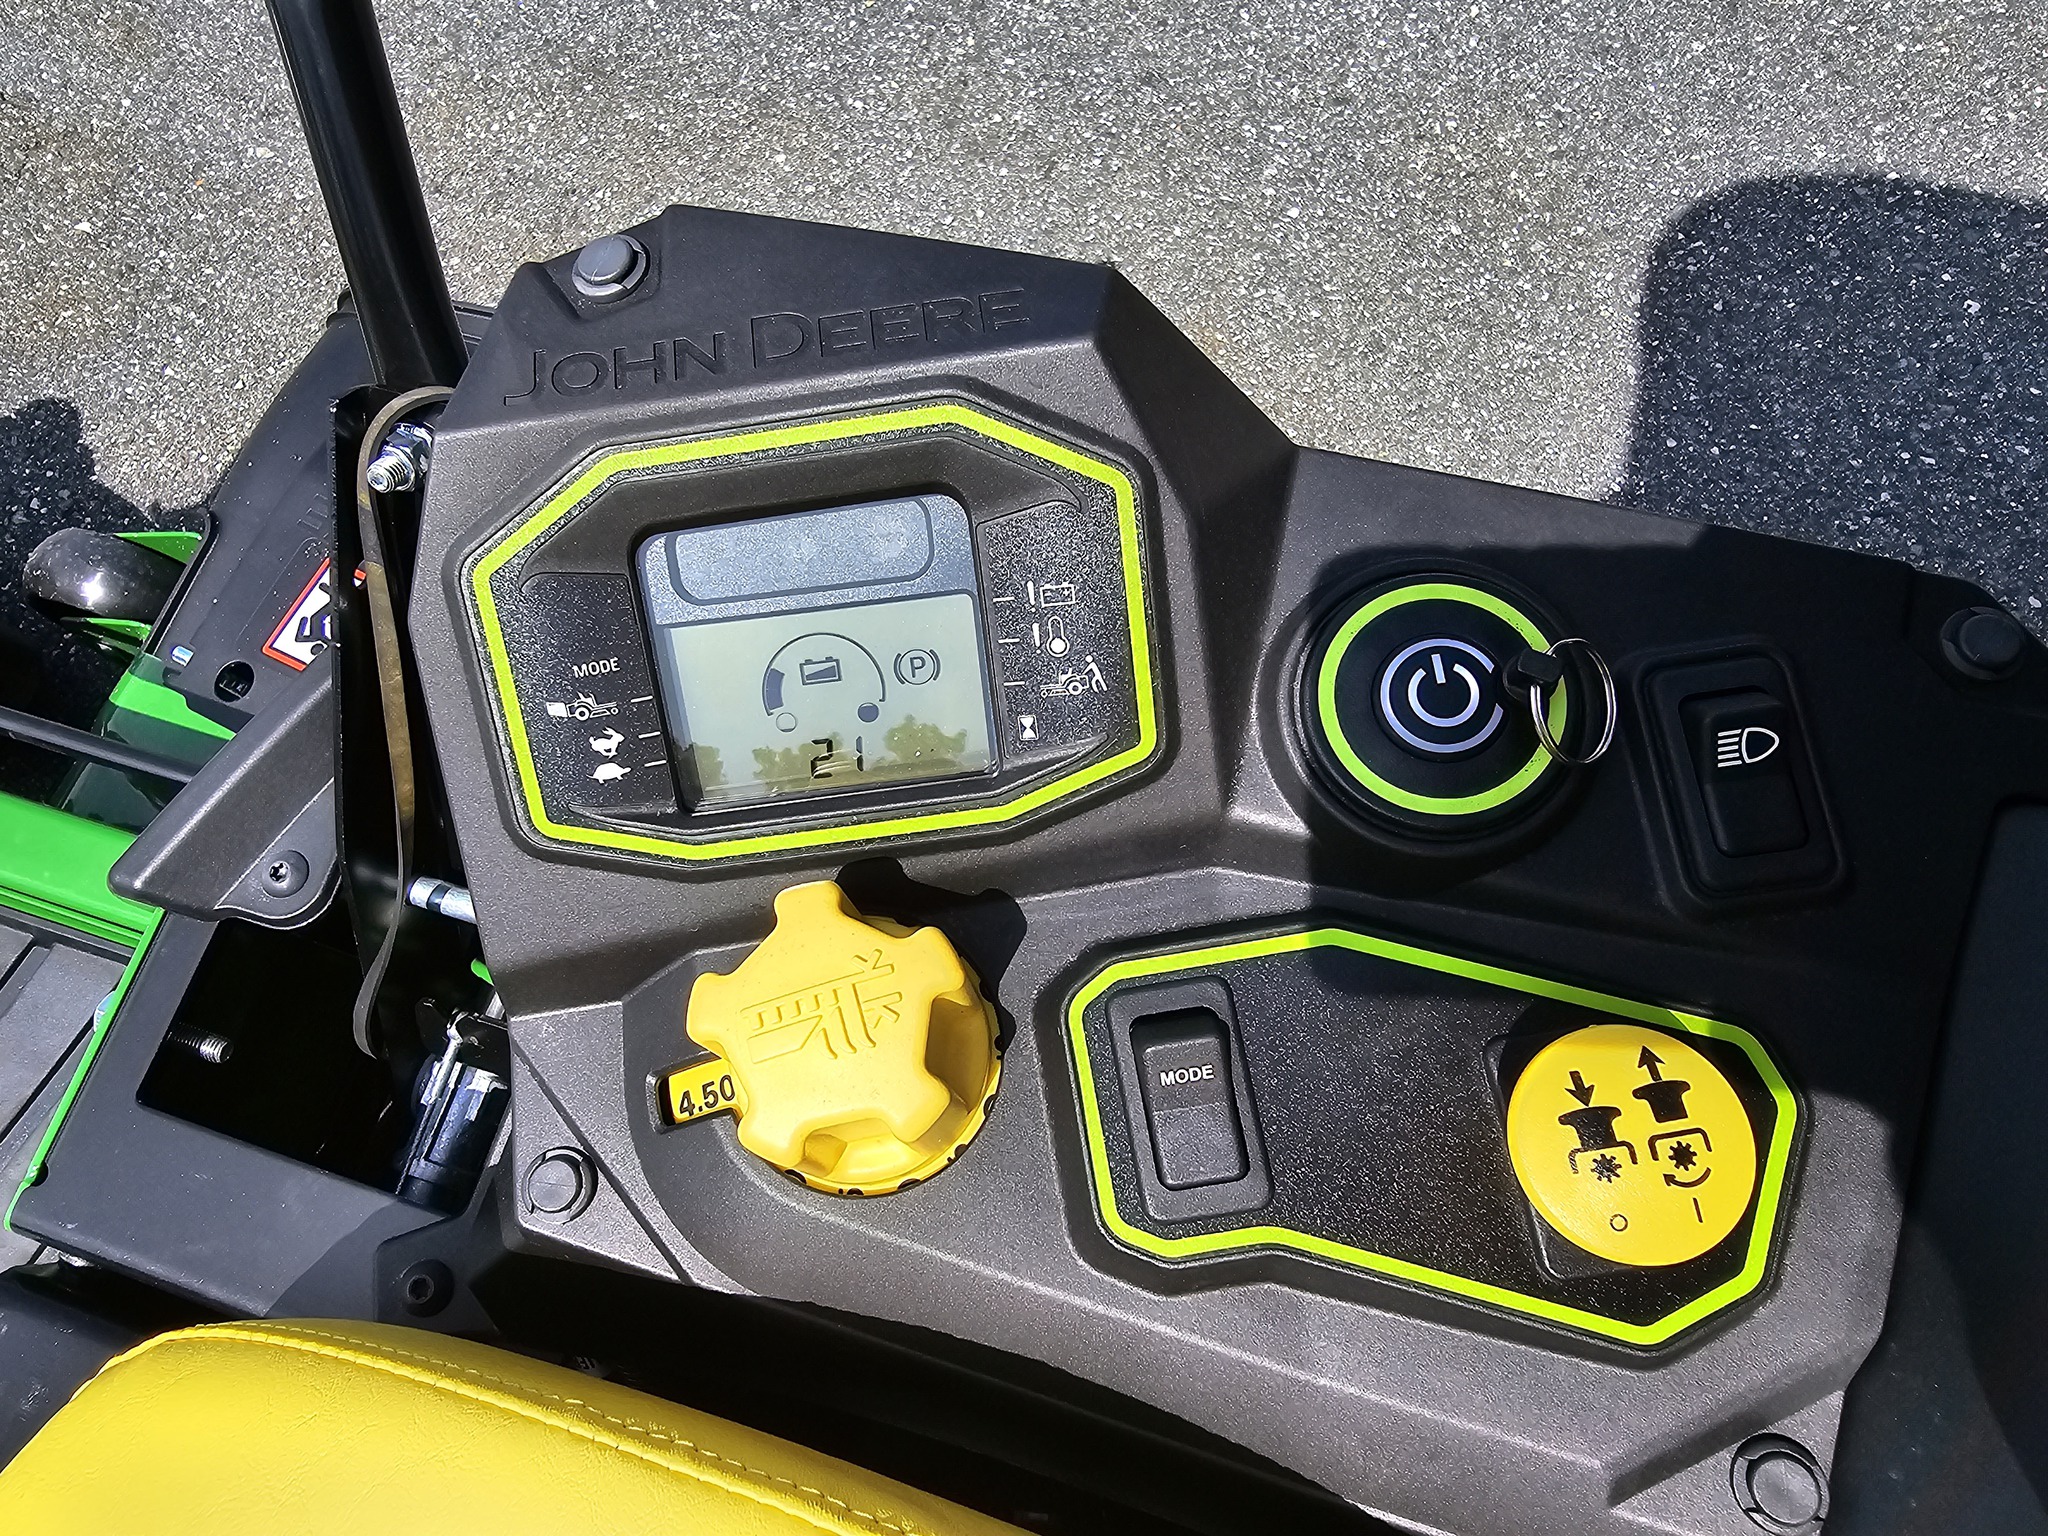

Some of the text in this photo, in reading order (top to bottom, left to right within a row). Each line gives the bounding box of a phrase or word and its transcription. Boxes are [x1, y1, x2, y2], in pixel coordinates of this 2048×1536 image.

[504, 287, 1031, 406] JOHN DEERE
[571, 656, 621, 679] MODE
[1160, 1063, 1215, 1087] MODE
[679, 1074, 736, 1117] 4.50
